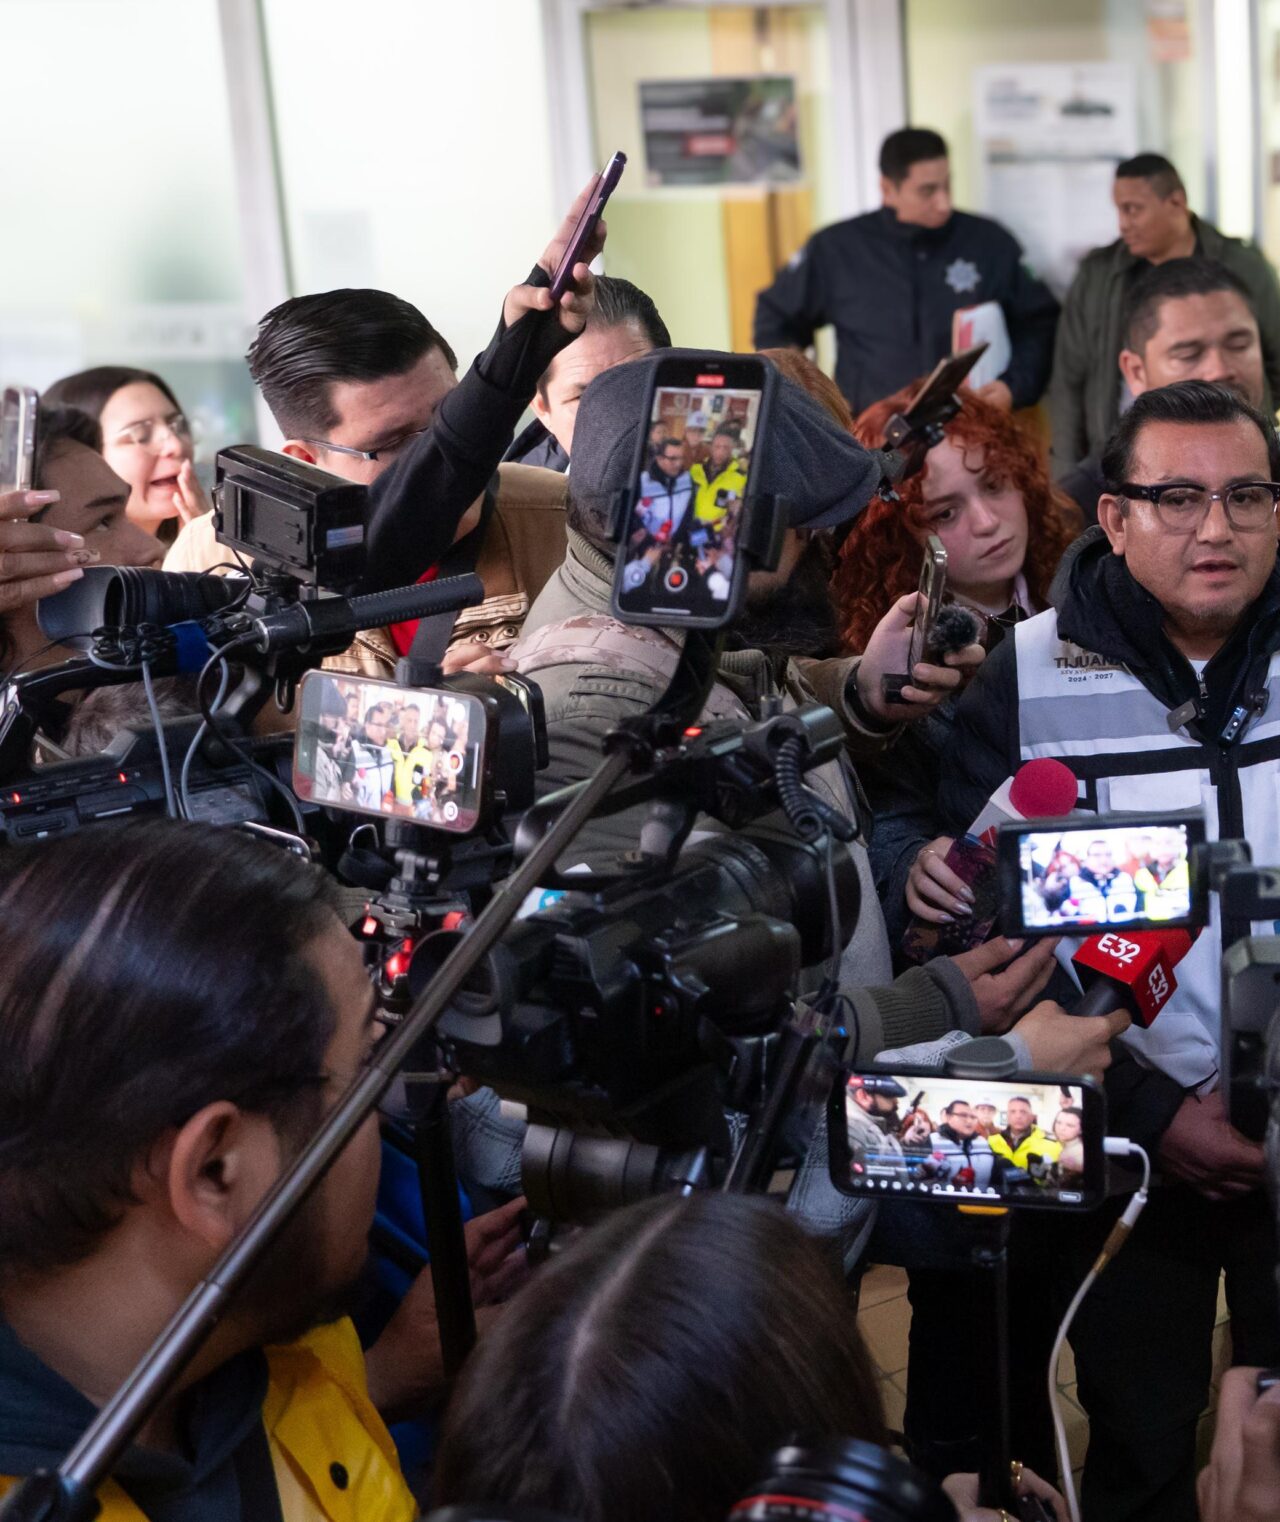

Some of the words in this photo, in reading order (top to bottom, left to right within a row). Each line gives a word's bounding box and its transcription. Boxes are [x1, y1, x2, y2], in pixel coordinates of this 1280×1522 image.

[1094, 672, 1114, 680] 2027
[1097, 932, 1140, 963] E32
[1148, 962, 1169, 1004] E32
